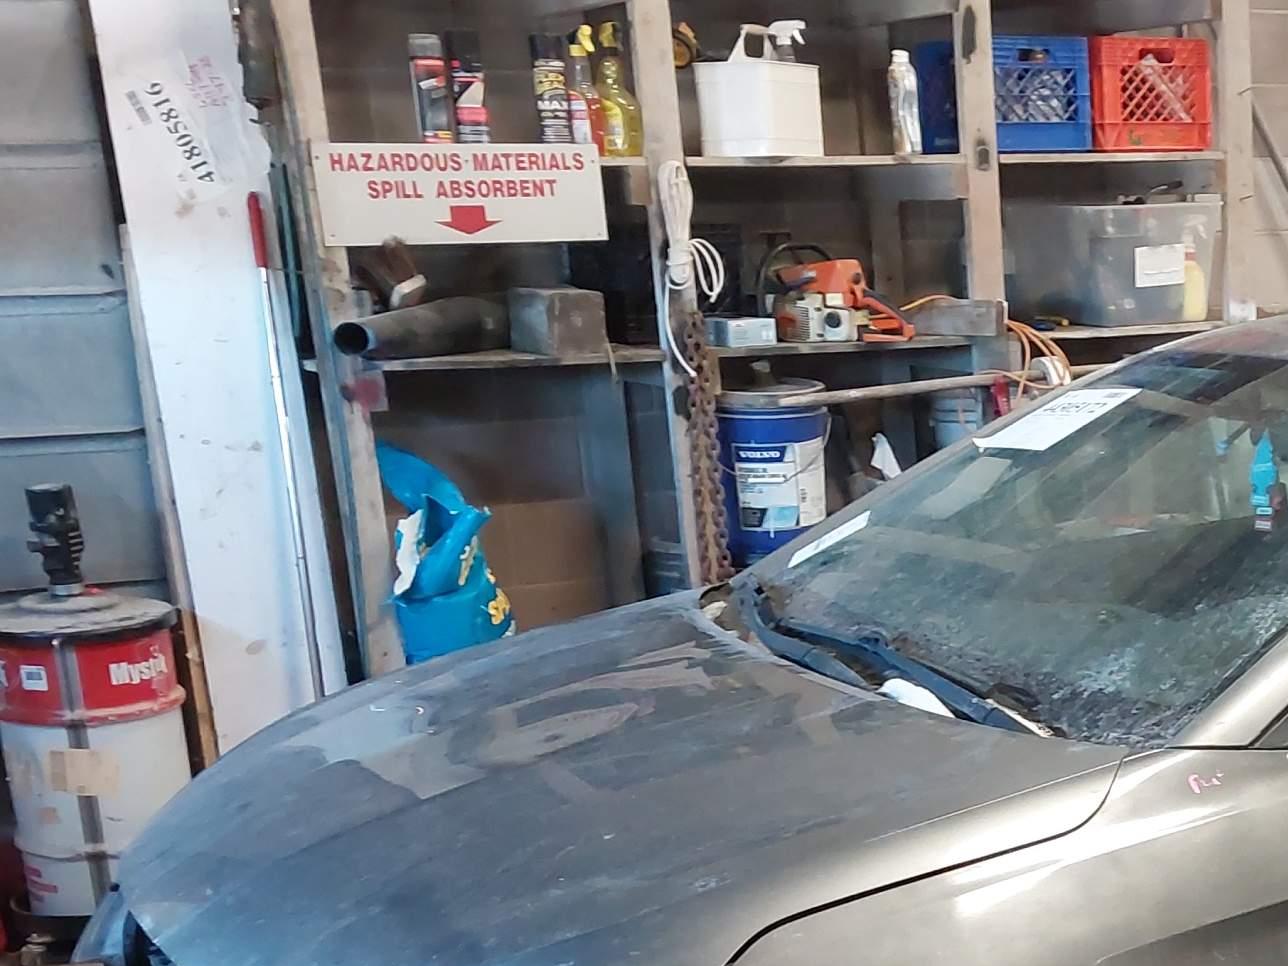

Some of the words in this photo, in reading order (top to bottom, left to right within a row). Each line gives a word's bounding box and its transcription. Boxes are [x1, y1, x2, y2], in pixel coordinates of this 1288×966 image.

[144, 82, 216, 183] 41805816
[329, 152, 463, 172] HAZARDOUS
[473, 152, 585, 172] MATERIALS
[367, 180, 424, 199] SPILL
[436, 179, 557, 199] ABSORBENT
[738, 450, 781, 459] VOLVO
